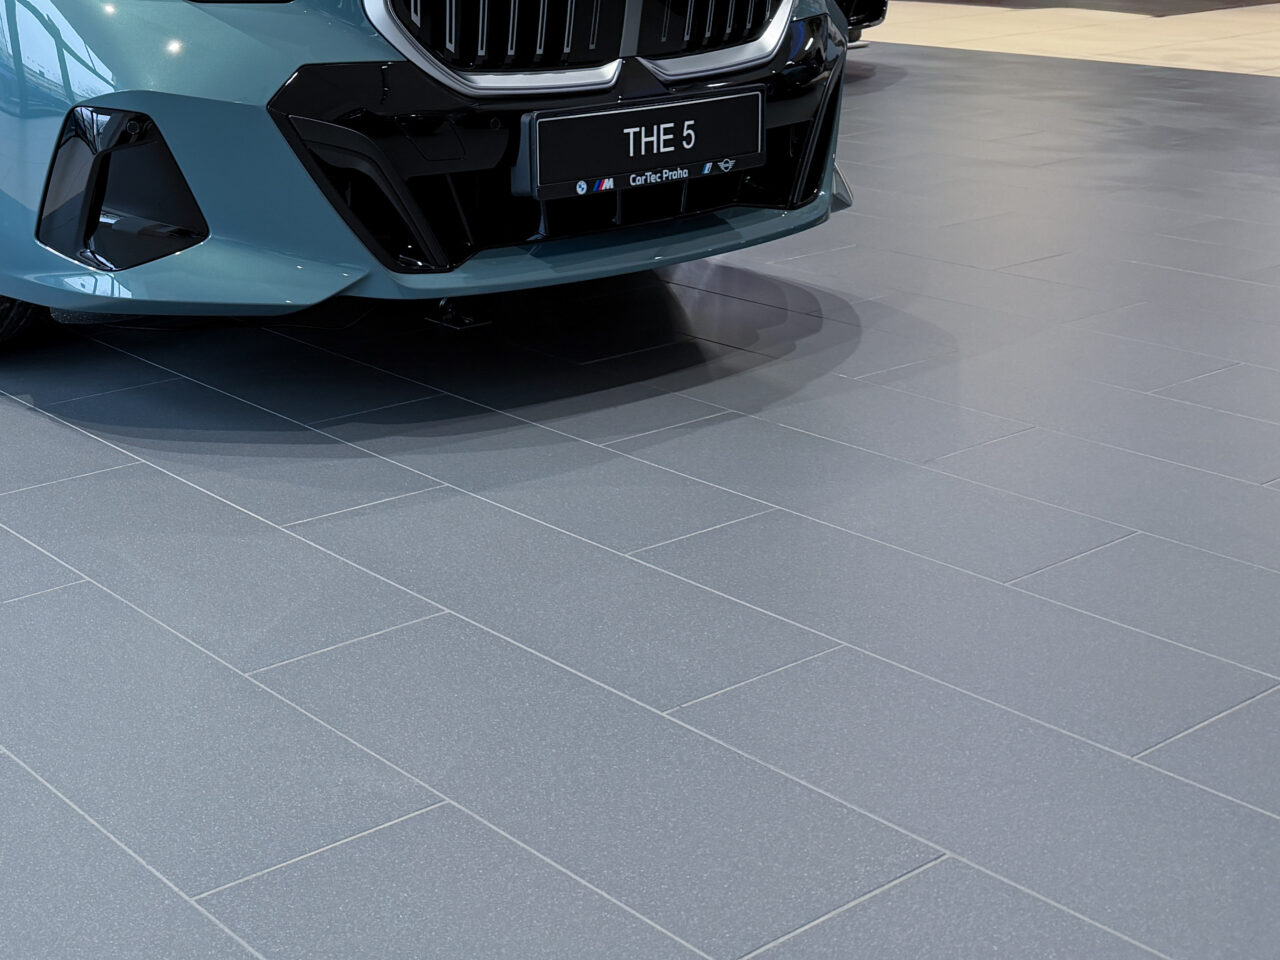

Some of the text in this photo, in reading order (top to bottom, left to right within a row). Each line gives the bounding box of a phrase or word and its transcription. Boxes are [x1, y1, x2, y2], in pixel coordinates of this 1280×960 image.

[623, 120, 696, 157] THE 5
[629, 171, 661, 186] CarTec
[662, 167, 689, 181] Praha
